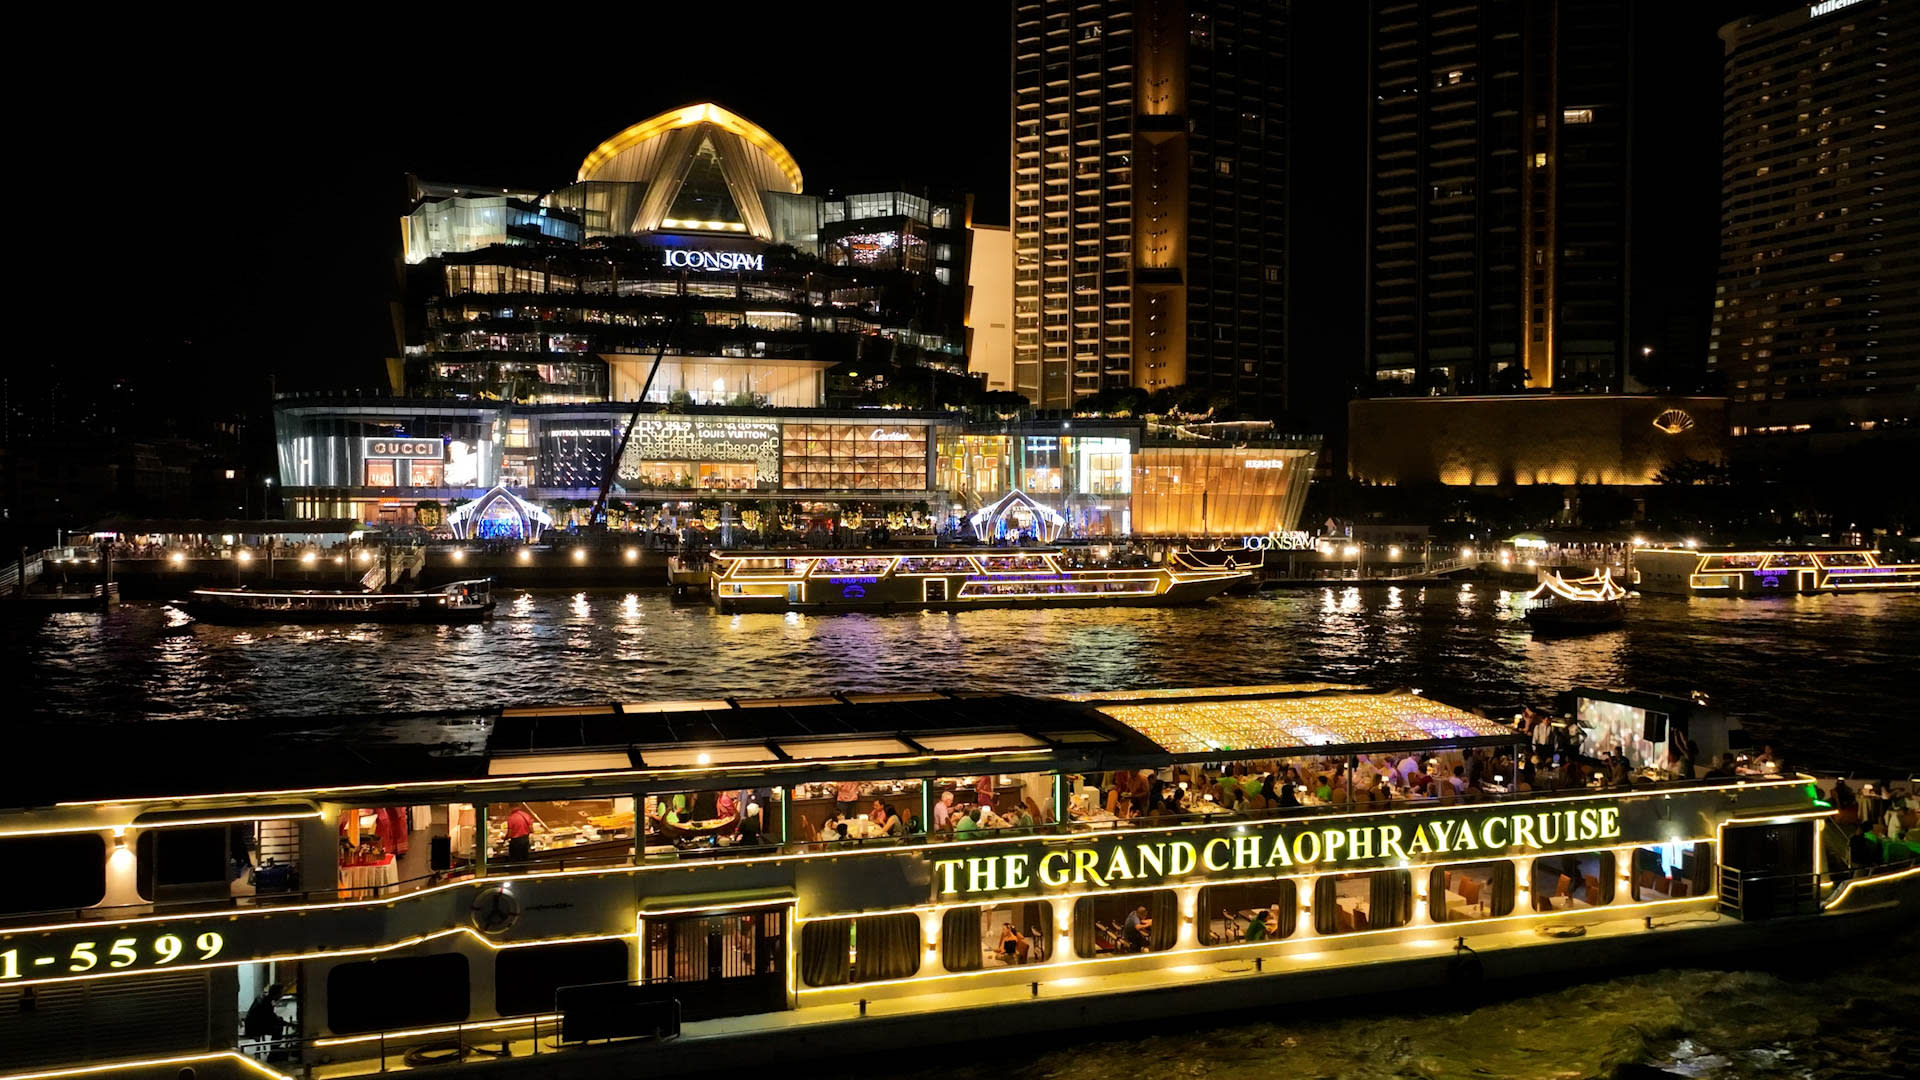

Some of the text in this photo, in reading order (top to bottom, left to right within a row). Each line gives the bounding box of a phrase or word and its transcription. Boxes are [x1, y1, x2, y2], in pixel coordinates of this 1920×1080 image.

[663, 249, 764, 271] ICONSIAM
[698, 429, 767, 439] LOUIS VUITTON
[870, 428, 910, 441] Cartier
[374, 442, 433, 455] GUCCI
[1242, 536, 1315, 551] ICONSIAM
[935, 853, 1030, 895] THE
[1037, 840, 1197, 888] GRAND
[1481, 806, 1622, 850] CRUISE
